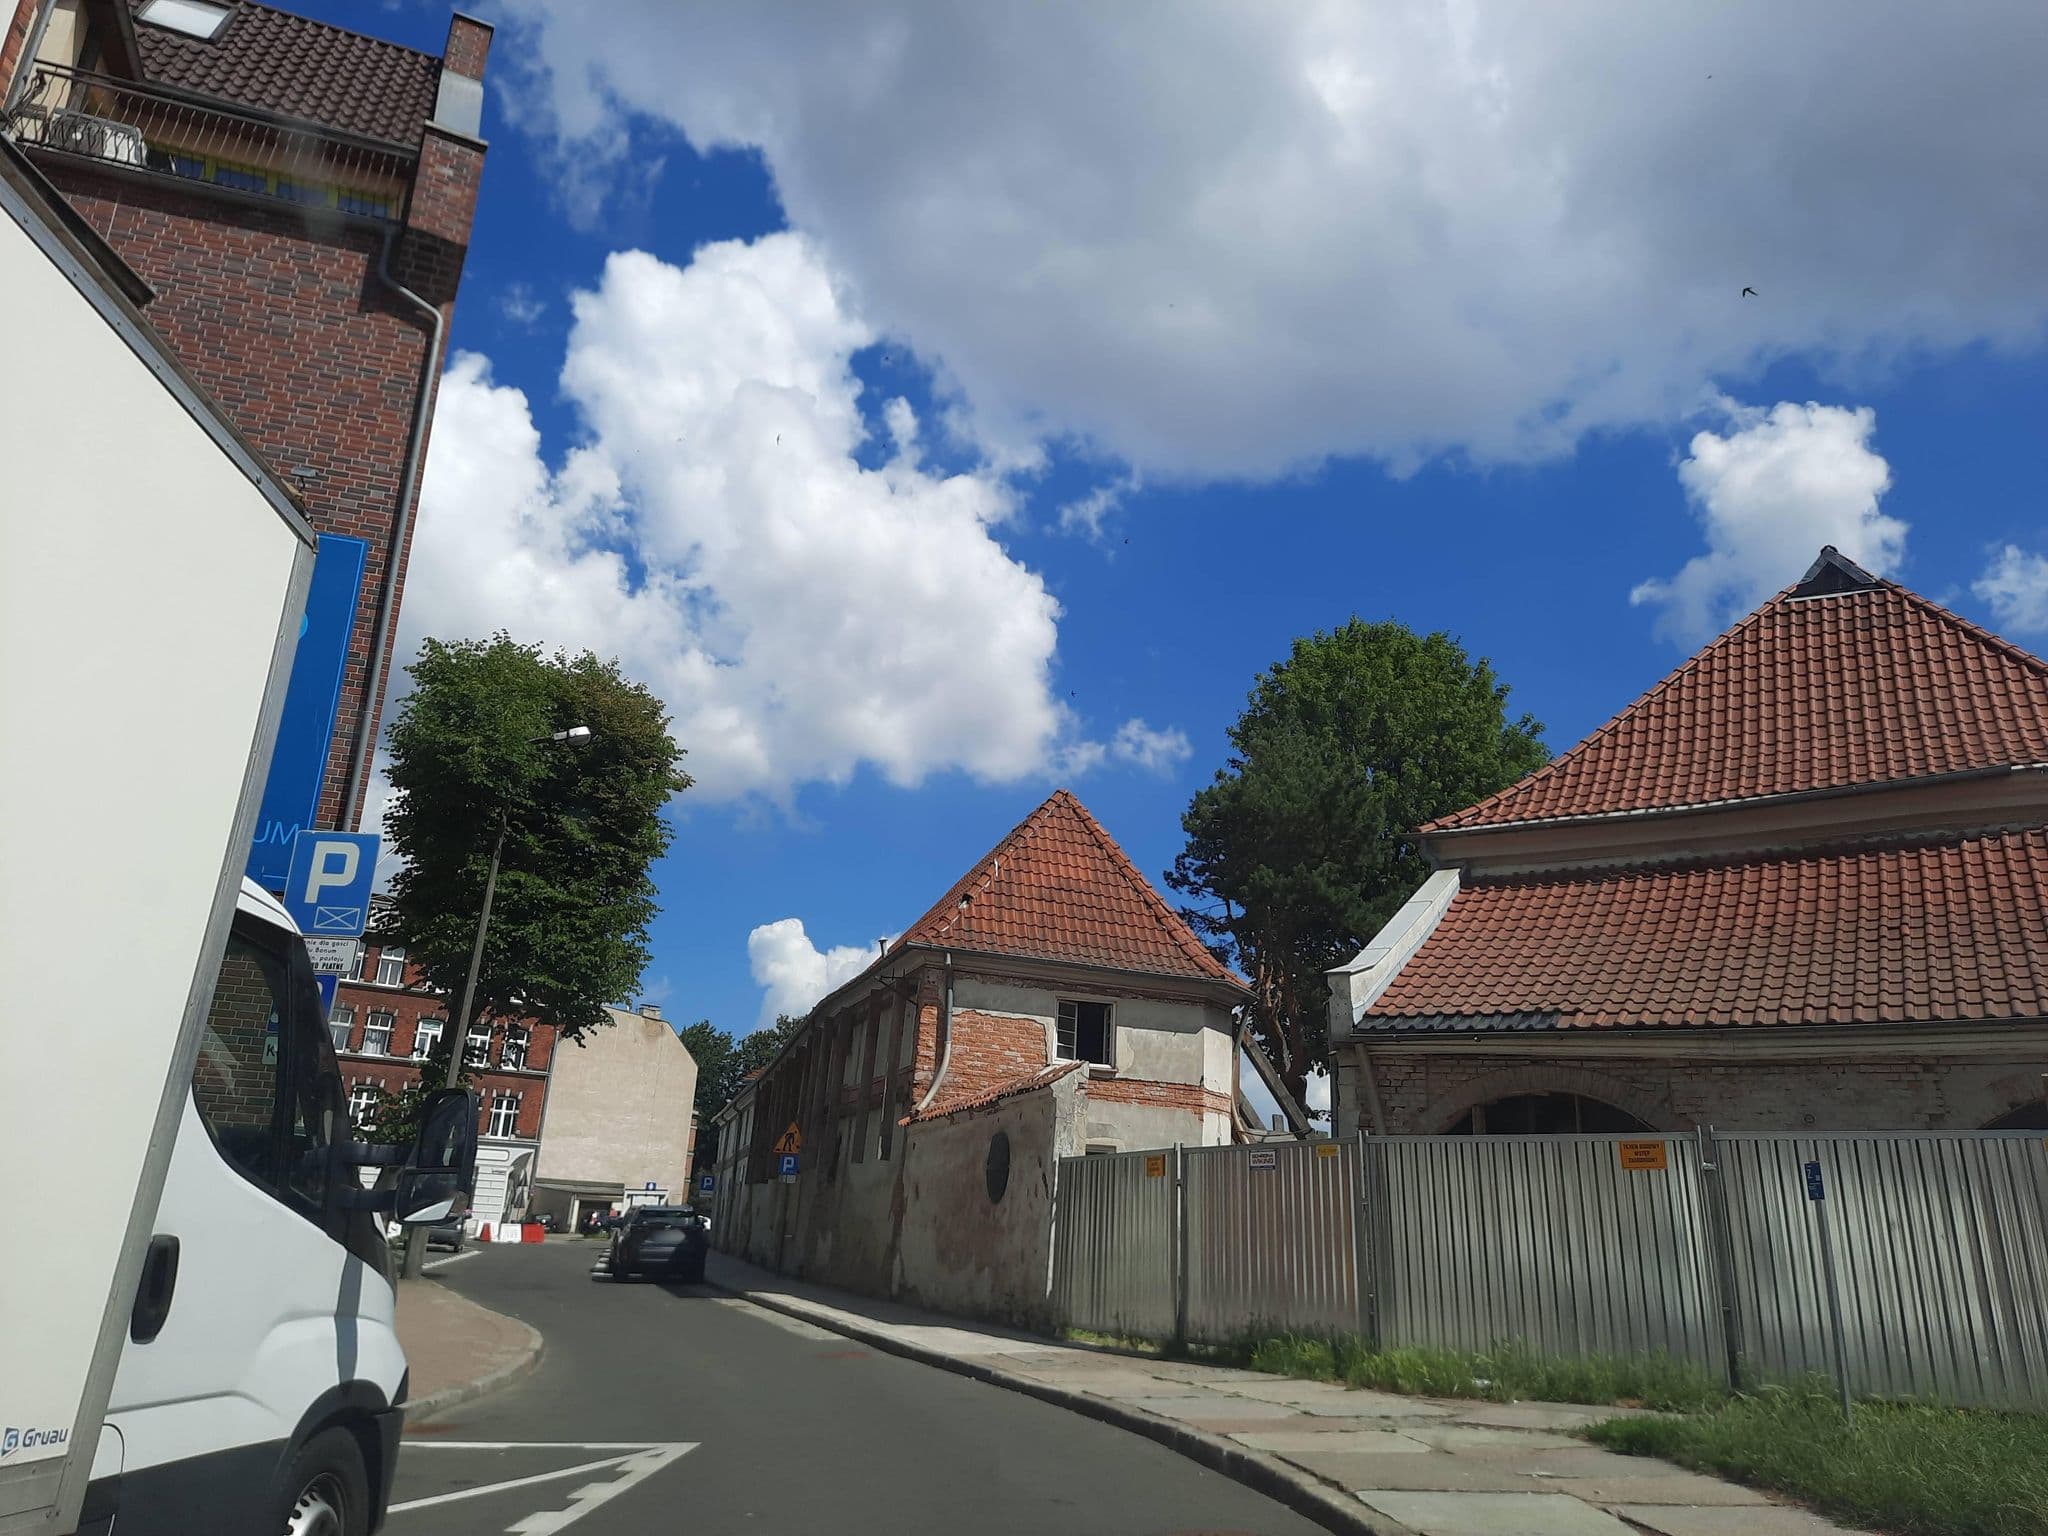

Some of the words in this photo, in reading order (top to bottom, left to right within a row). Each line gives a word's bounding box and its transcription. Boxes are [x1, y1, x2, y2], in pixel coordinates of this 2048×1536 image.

[304, 841, 360, 903] P
[783, 1157, 795, 1172] P
[703, 1177, 713, 1189] P
[23, 1427, 69, 1448] Gruau
